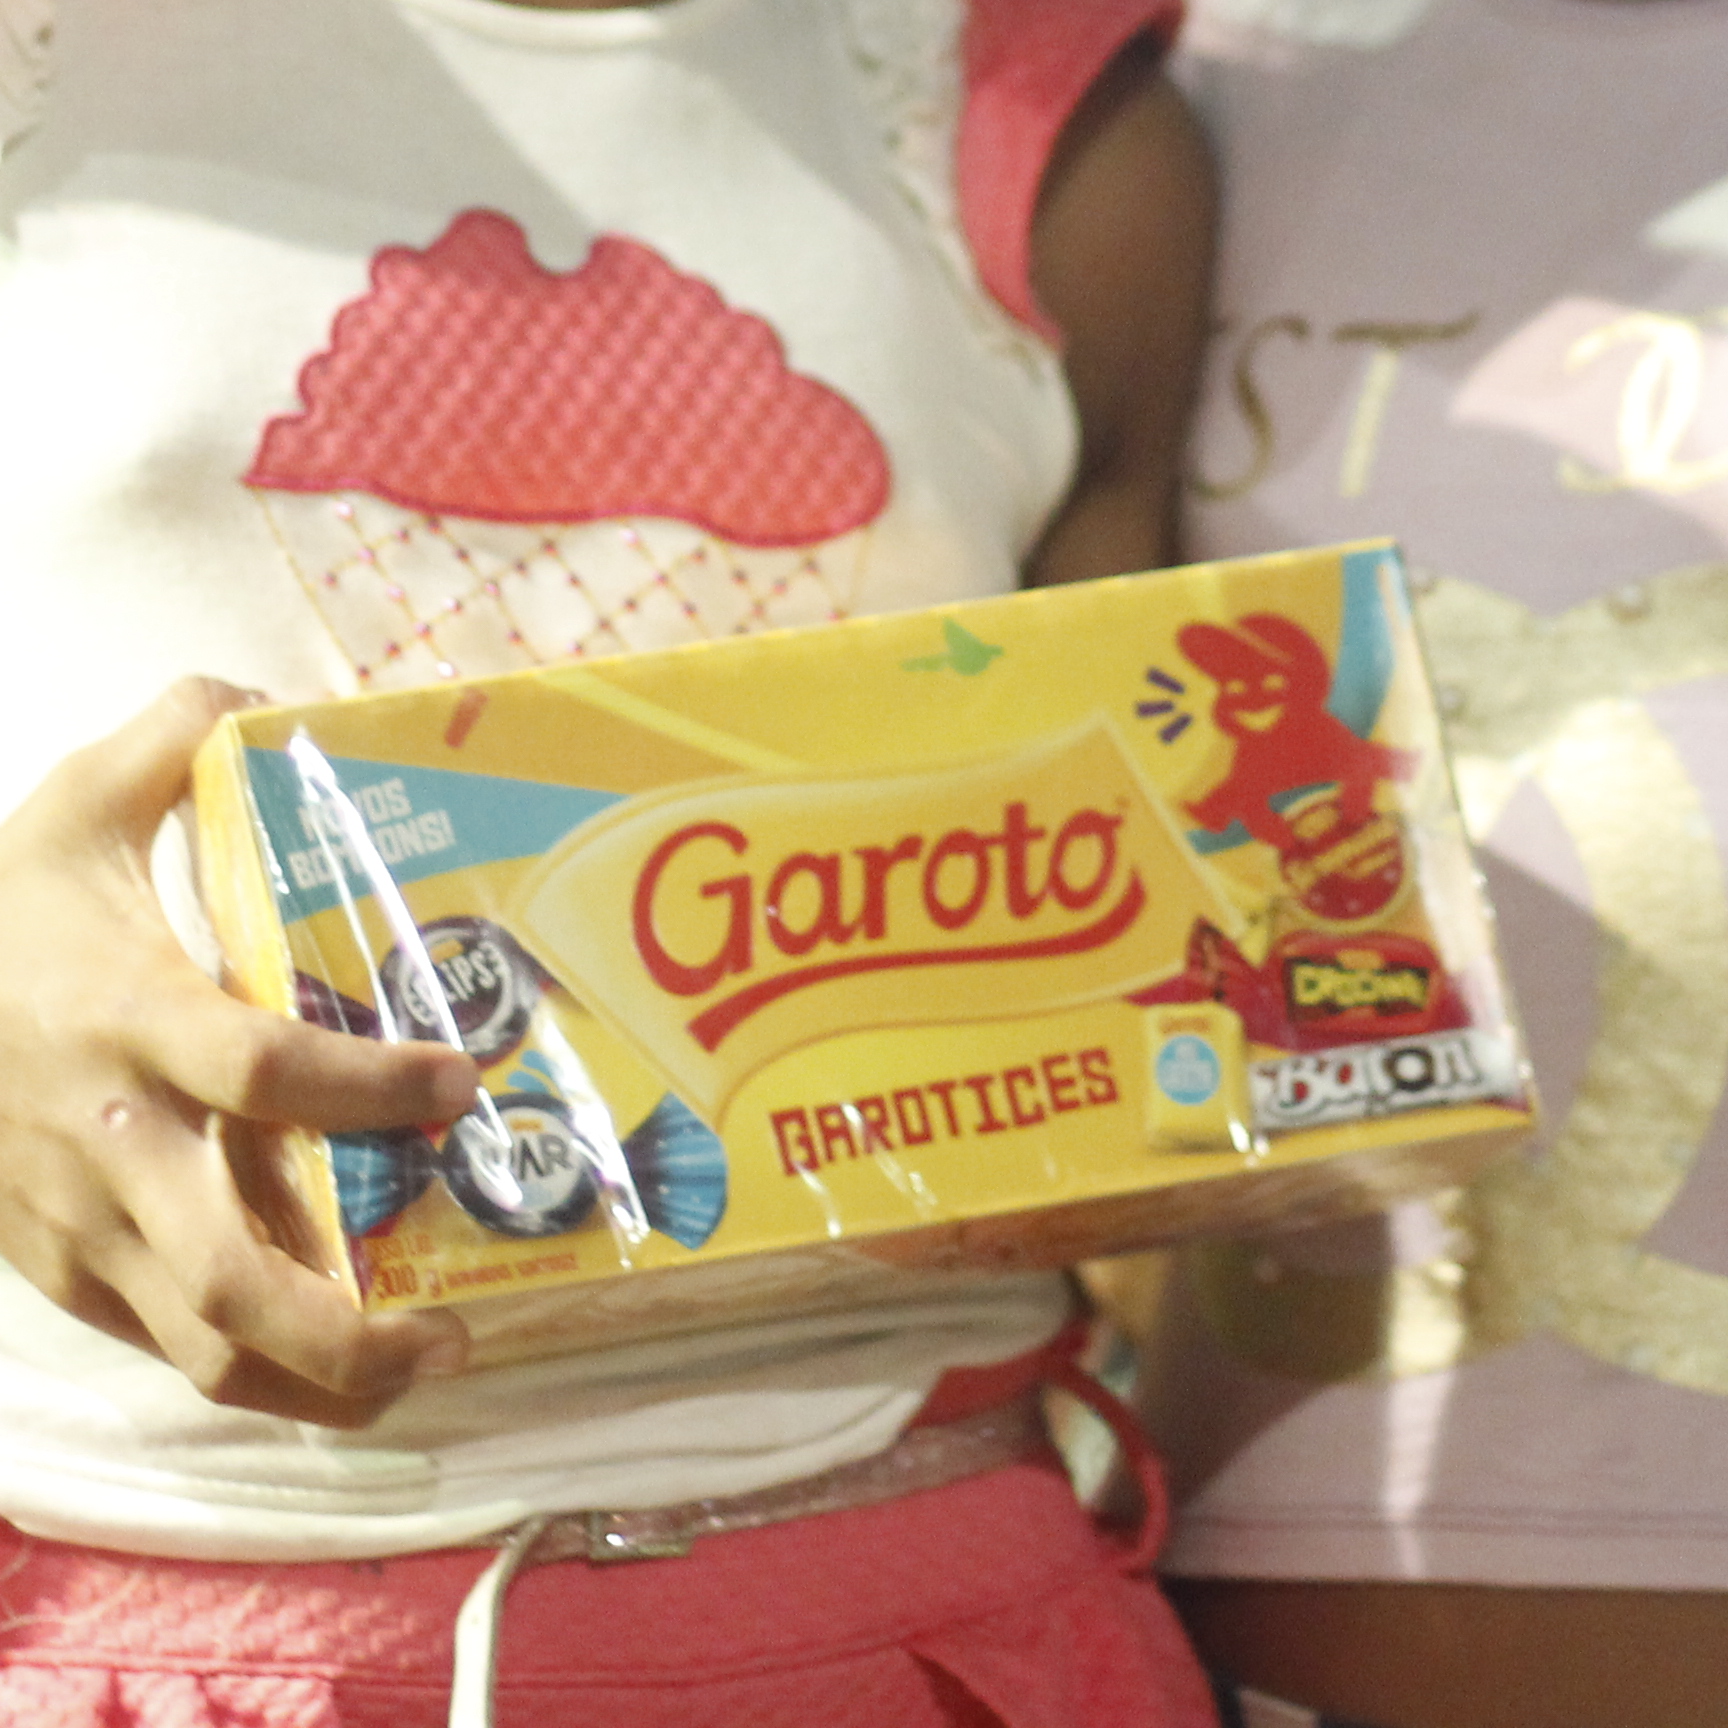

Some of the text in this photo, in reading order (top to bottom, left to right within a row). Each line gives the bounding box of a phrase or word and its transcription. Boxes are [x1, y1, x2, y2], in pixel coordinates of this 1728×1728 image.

[287, 808, 457, 891] BOMONS!
[631, 800, 1124, 998] Garoto
[408, 938, 506, 1027] EIPSE
[769, 1047, 1119, 1176] GAROTICES
